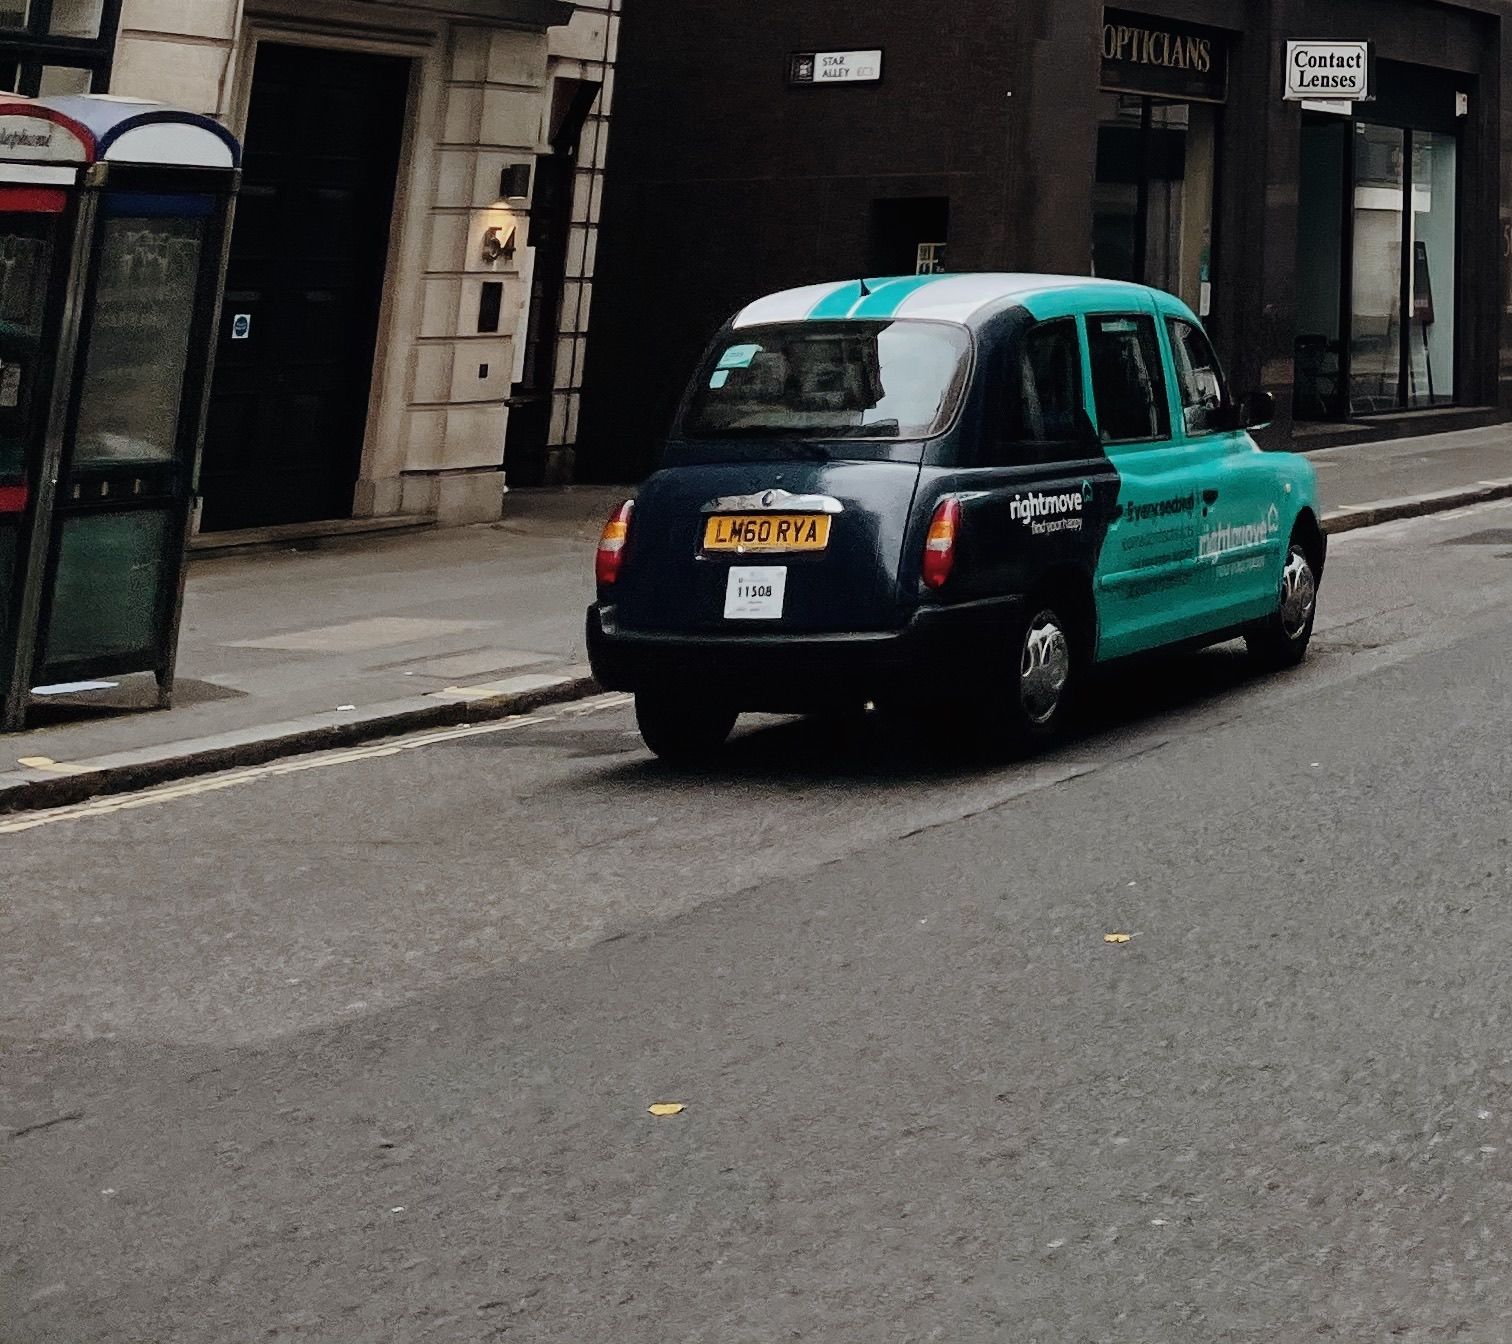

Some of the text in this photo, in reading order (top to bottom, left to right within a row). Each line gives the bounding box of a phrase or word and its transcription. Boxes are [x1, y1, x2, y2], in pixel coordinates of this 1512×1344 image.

[1103, 24, 1211, 73] OPTICIANS
[822, 56, 845, 67] STAR
[1294, 50, 1362, 69] Contact
[822, 68, 850, 78] ALLEY
[1298, 69, 1356, 88] Lenses
[482, 226, 517, 263] 54
[1010, 492, 1083, 525] rightmove
[715, 519, 817, 543] LM60 RYA
[738, 585, 772, 598] 11508
